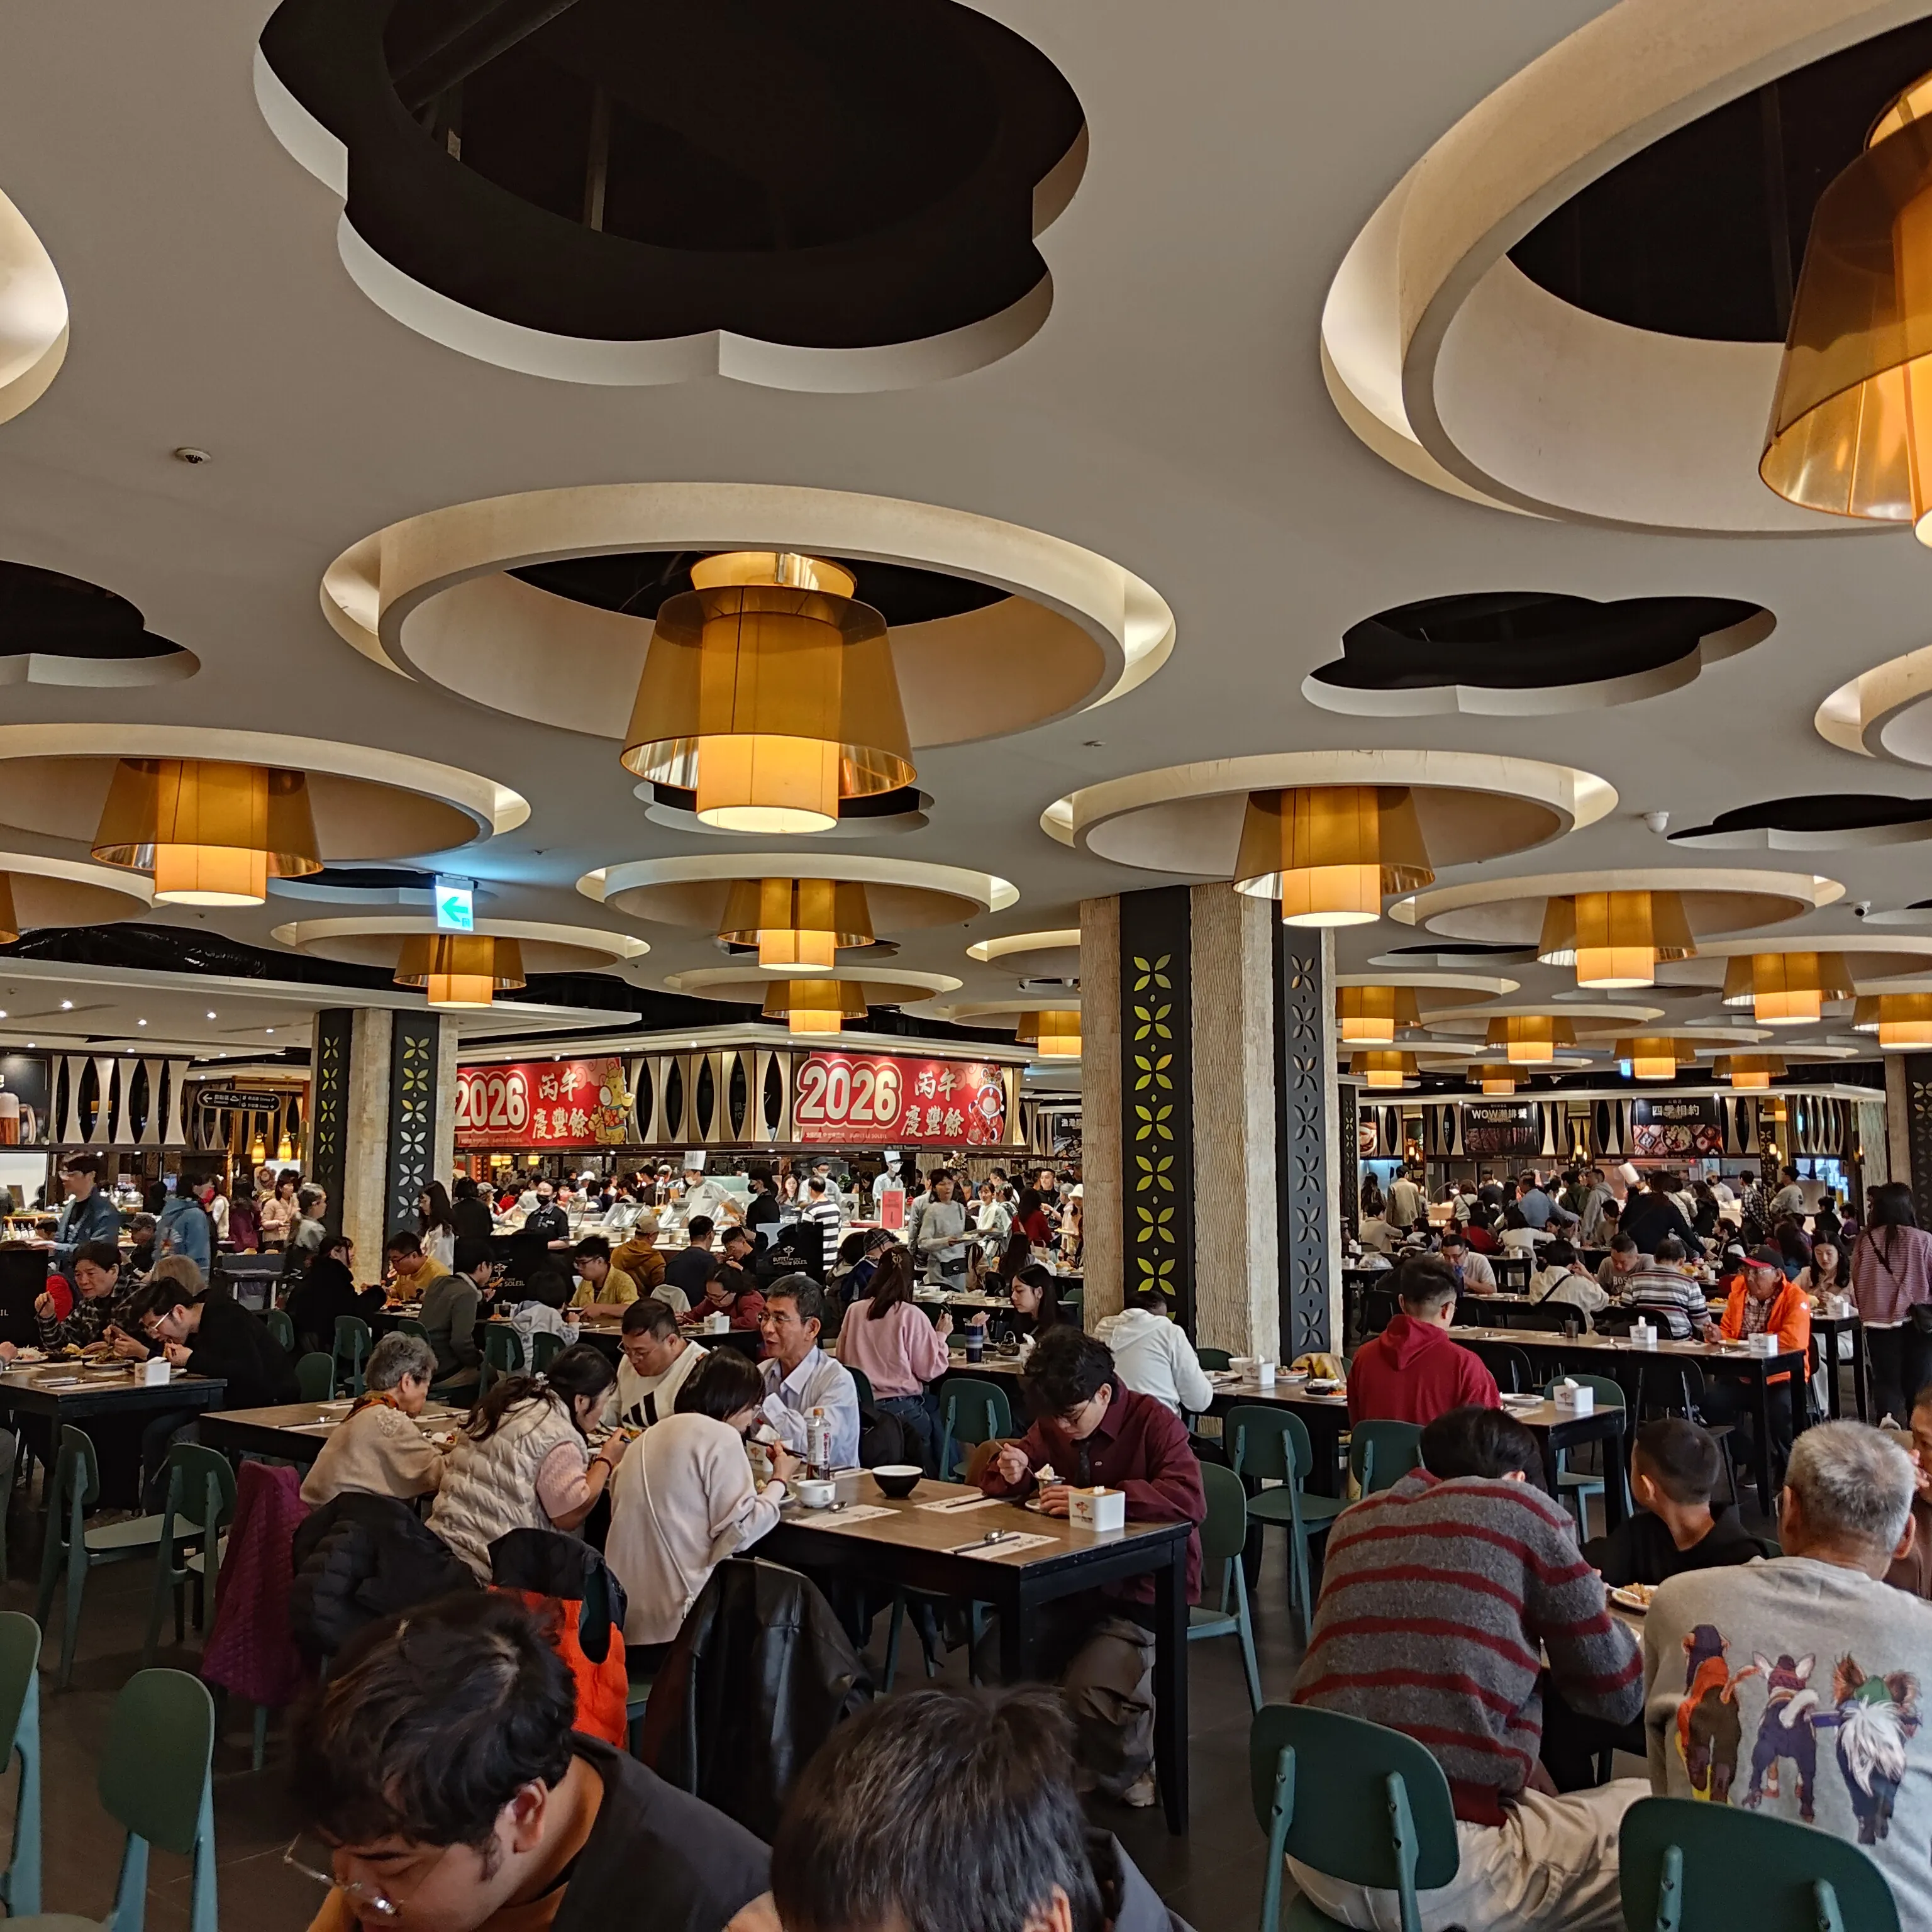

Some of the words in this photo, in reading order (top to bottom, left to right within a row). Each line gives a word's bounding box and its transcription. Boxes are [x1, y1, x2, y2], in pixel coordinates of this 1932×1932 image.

[455, 1077, 525, 1126] 2026
[538, 1068, 579, 1102] 丙午
[800, 1065, 897, 1121] 2026
[915, 1068, 957, 1101] 丙午
